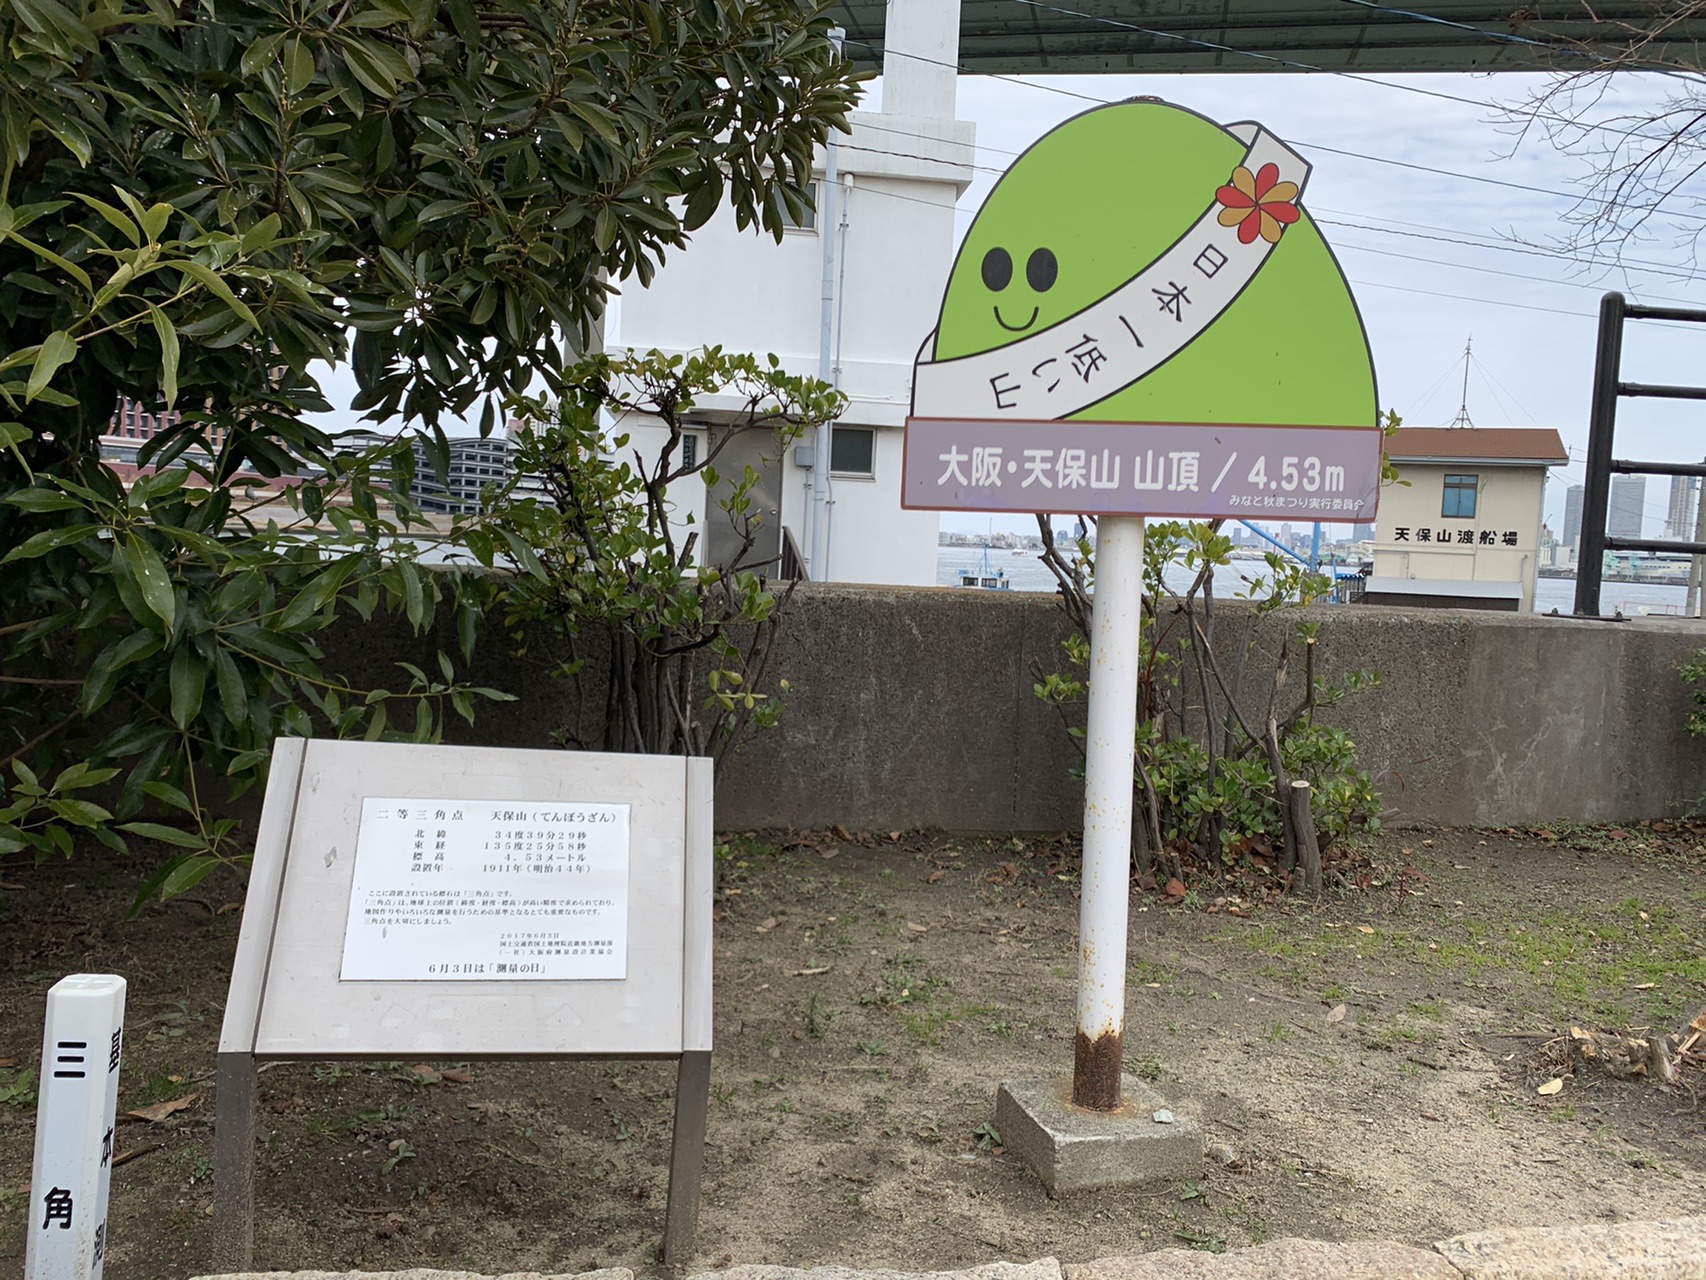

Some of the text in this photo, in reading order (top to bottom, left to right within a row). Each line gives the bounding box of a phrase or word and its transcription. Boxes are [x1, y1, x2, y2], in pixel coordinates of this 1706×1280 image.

[989, 243, 1229, 409] 日本一低い山
[937, 445, 1120, 488] 大阪・天保山
[1134, 449, 1200, 492] 山頂
[1247, 455, 1346, 493] 4.53m
[1228, 494, 1365, 512] みなと秋まつり実行委員会
[1394, 527, 1518, 547] 天保山渡船場
[376, 807, 464, 821] 二等三角点
[414, 829, 587, 841] 北緯 34度39分29秒
[413, 840, 587, 852] 東経 135度25分58秒
[412, 852, 445, 862] 標高
[411, 863, 444, 873] 設置年
[428, 962, 547, 974] 6月3日は「測量の日」
